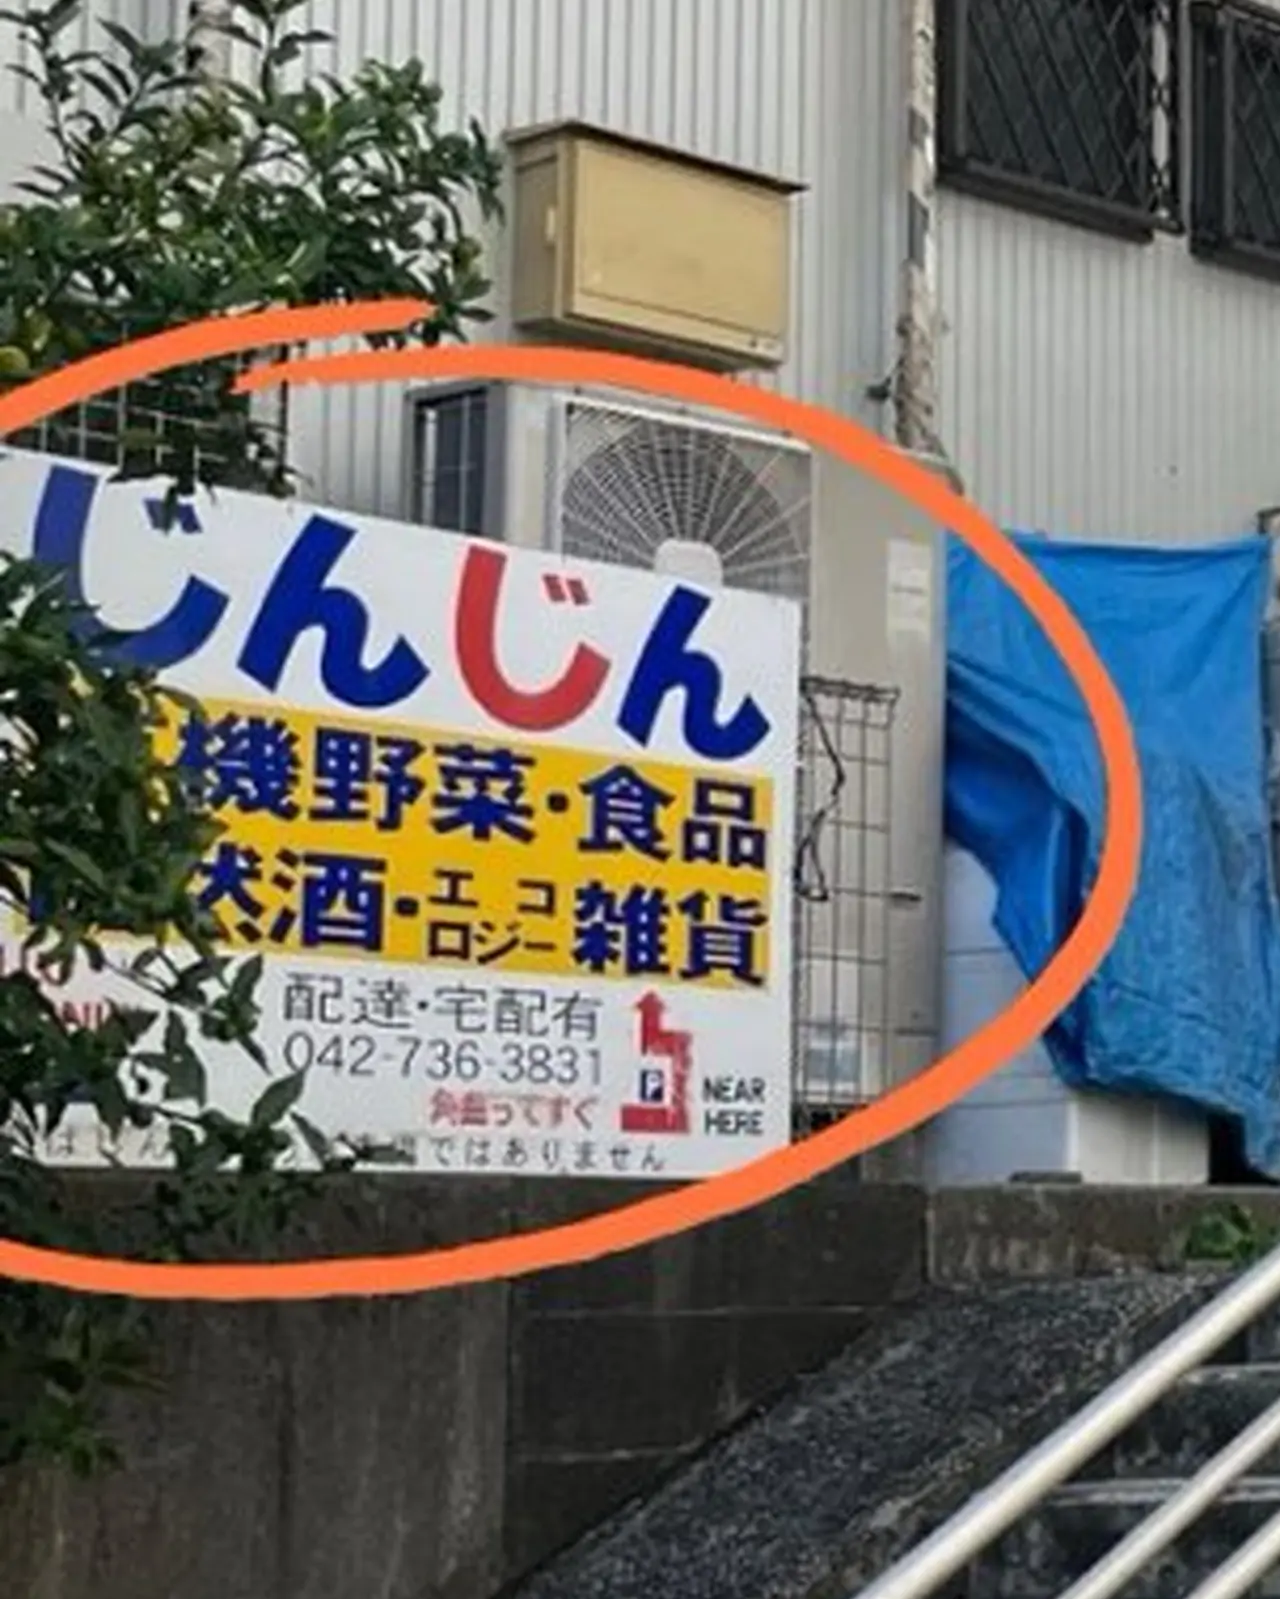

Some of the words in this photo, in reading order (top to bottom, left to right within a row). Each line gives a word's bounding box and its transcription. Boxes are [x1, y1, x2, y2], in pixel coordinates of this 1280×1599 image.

[32, 464, 771, 760] じんじん
[283, 970, 604, 1042] 配達・宅配有
[283, 1032, 604, 1086] 042-736-3831
[703, 1075, 767, 1104] NEAR
[703, 1110, 766, 1137] HERE
